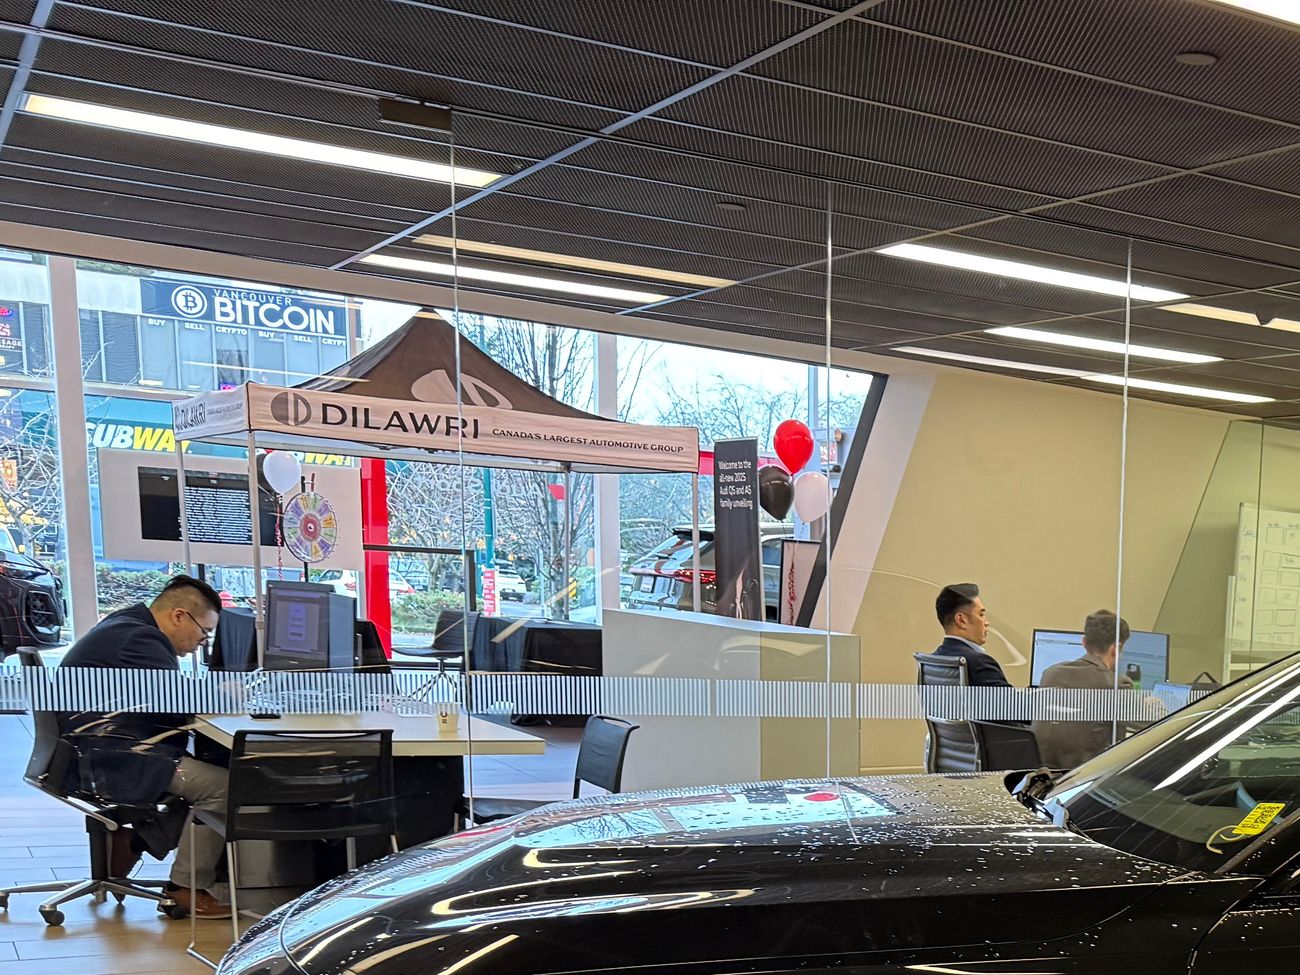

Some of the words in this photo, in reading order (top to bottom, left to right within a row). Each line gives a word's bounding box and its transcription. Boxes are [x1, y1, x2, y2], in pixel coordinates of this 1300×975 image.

[214, 288, 292, 306] VANCOUVER
[214, 296, 335, 334] BITCOIN
[148, 318, 166, 326] BUY
[184, 321, 205, 331] SELL
[215, 325, 248, 336] CRYPTO
[258, 330, 275, 339] BUY
[293, 334, 313, 343] SELL
[321, 403, 479, 439] DILAWRI
[492, 428, 542, 440] CANADA'S
[543, 434, 588, 445] LARGEST
[589, 439, 648, 450] AUTOMOTIVE
[650, 443, 684, 453] GROUP
[718, 461, 738, 469] Welcome
[743, 460, 751, 468] the
[719, 473, 734, 482] all-new
[734, 472, 746, 482] 2025
[720, 485, 728, 495] Audi
[736, 485, 744, 495] and
[720, 498, 732, 510] family
